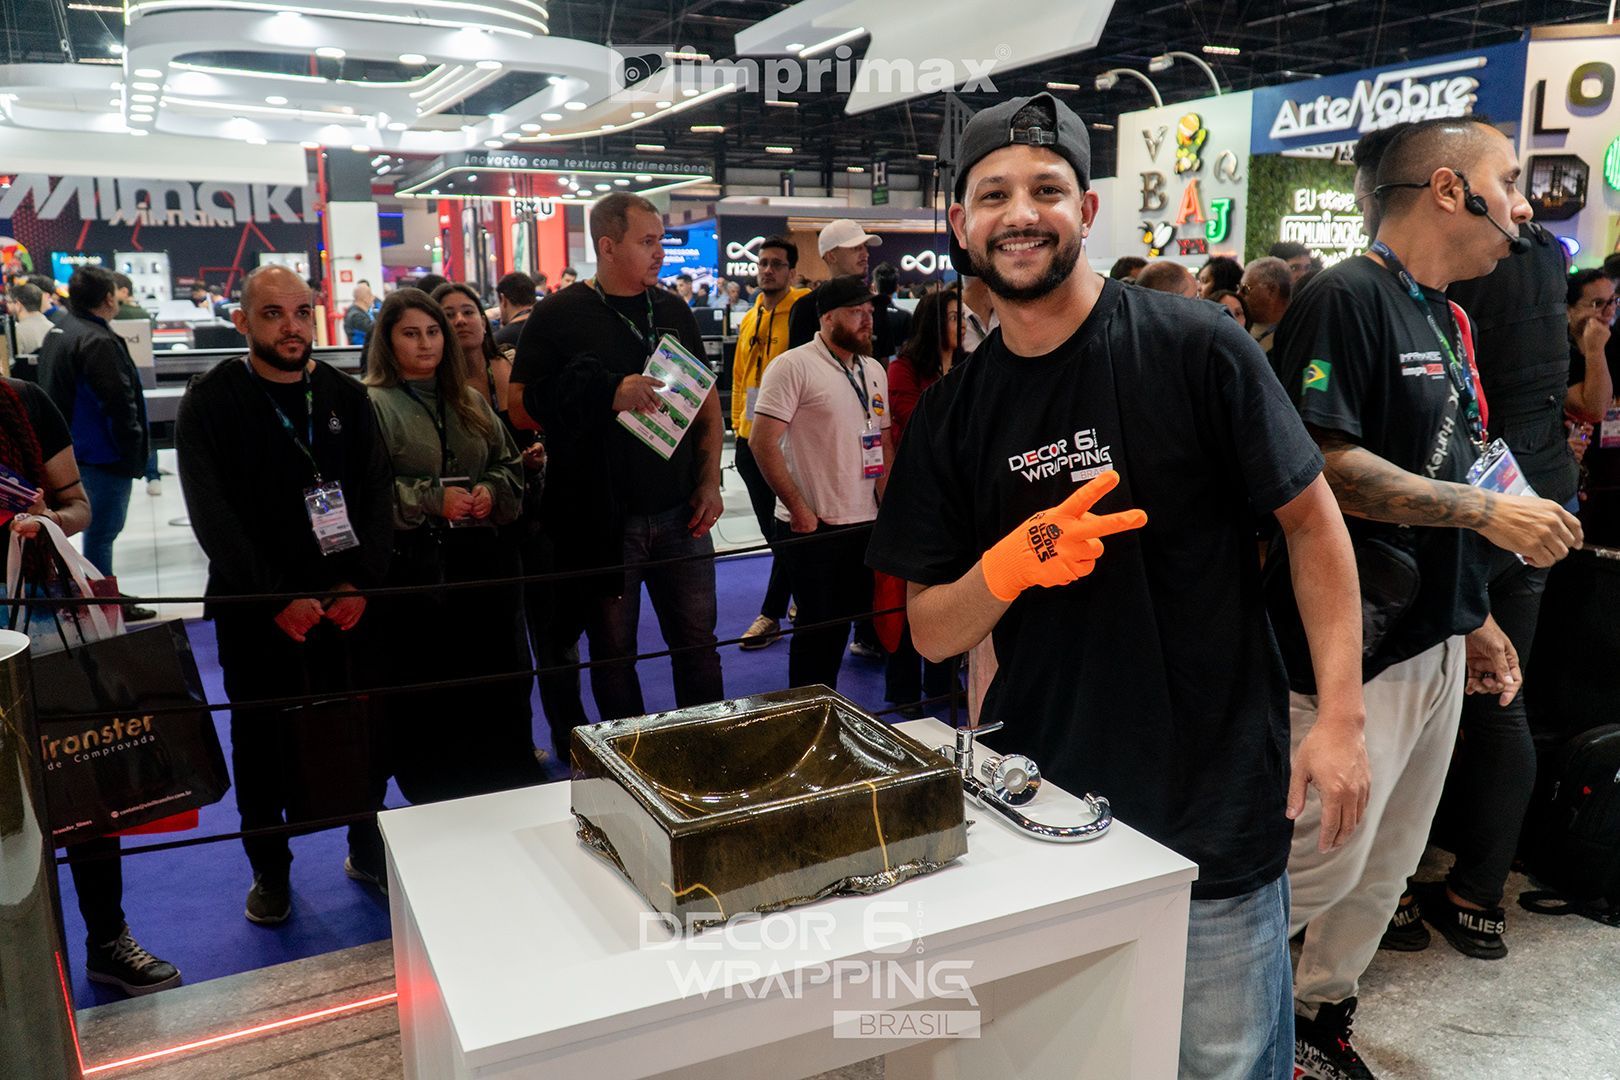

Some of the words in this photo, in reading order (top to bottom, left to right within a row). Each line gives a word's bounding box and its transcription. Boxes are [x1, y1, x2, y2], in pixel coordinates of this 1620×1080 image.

[532, 158, 559, 168] com
[564, 159, 617, 170] texturas
[1008, 439, 1067, 472] DECOR
[1074, 429, 1094, 451] 6
[1021, 445, 1112, 483] WRAPPING
[1426, 416, 1455, 478] Hurley
[47, 761, 62, 772] de
[74, 734, 155, 763] Comprovada
